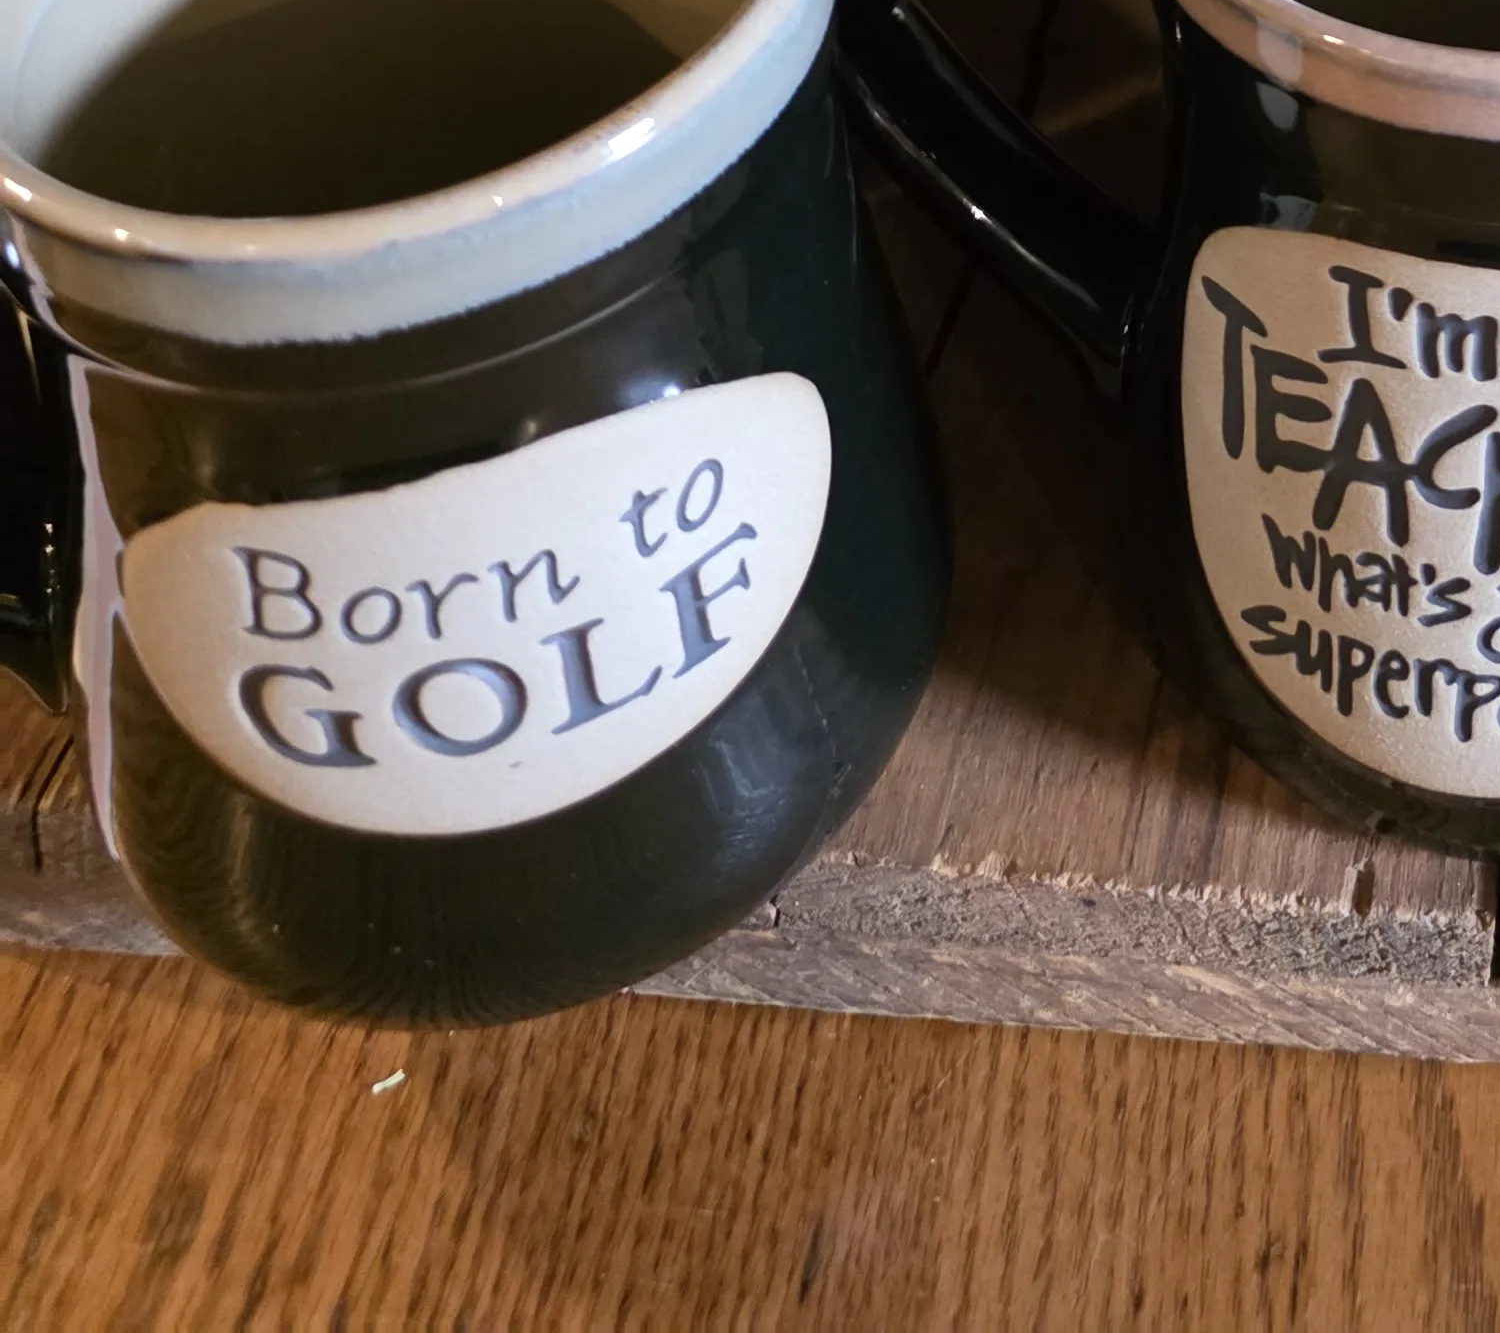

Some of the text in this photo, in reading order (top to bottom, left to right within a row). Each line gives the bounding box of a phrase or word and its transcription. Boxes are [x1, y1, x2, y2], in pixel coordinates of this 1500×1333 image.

[1317, 265, 1499, 383] I'm
[231, 457, 726, 645] Born to
[237, 522, 758, 769] GOLF
